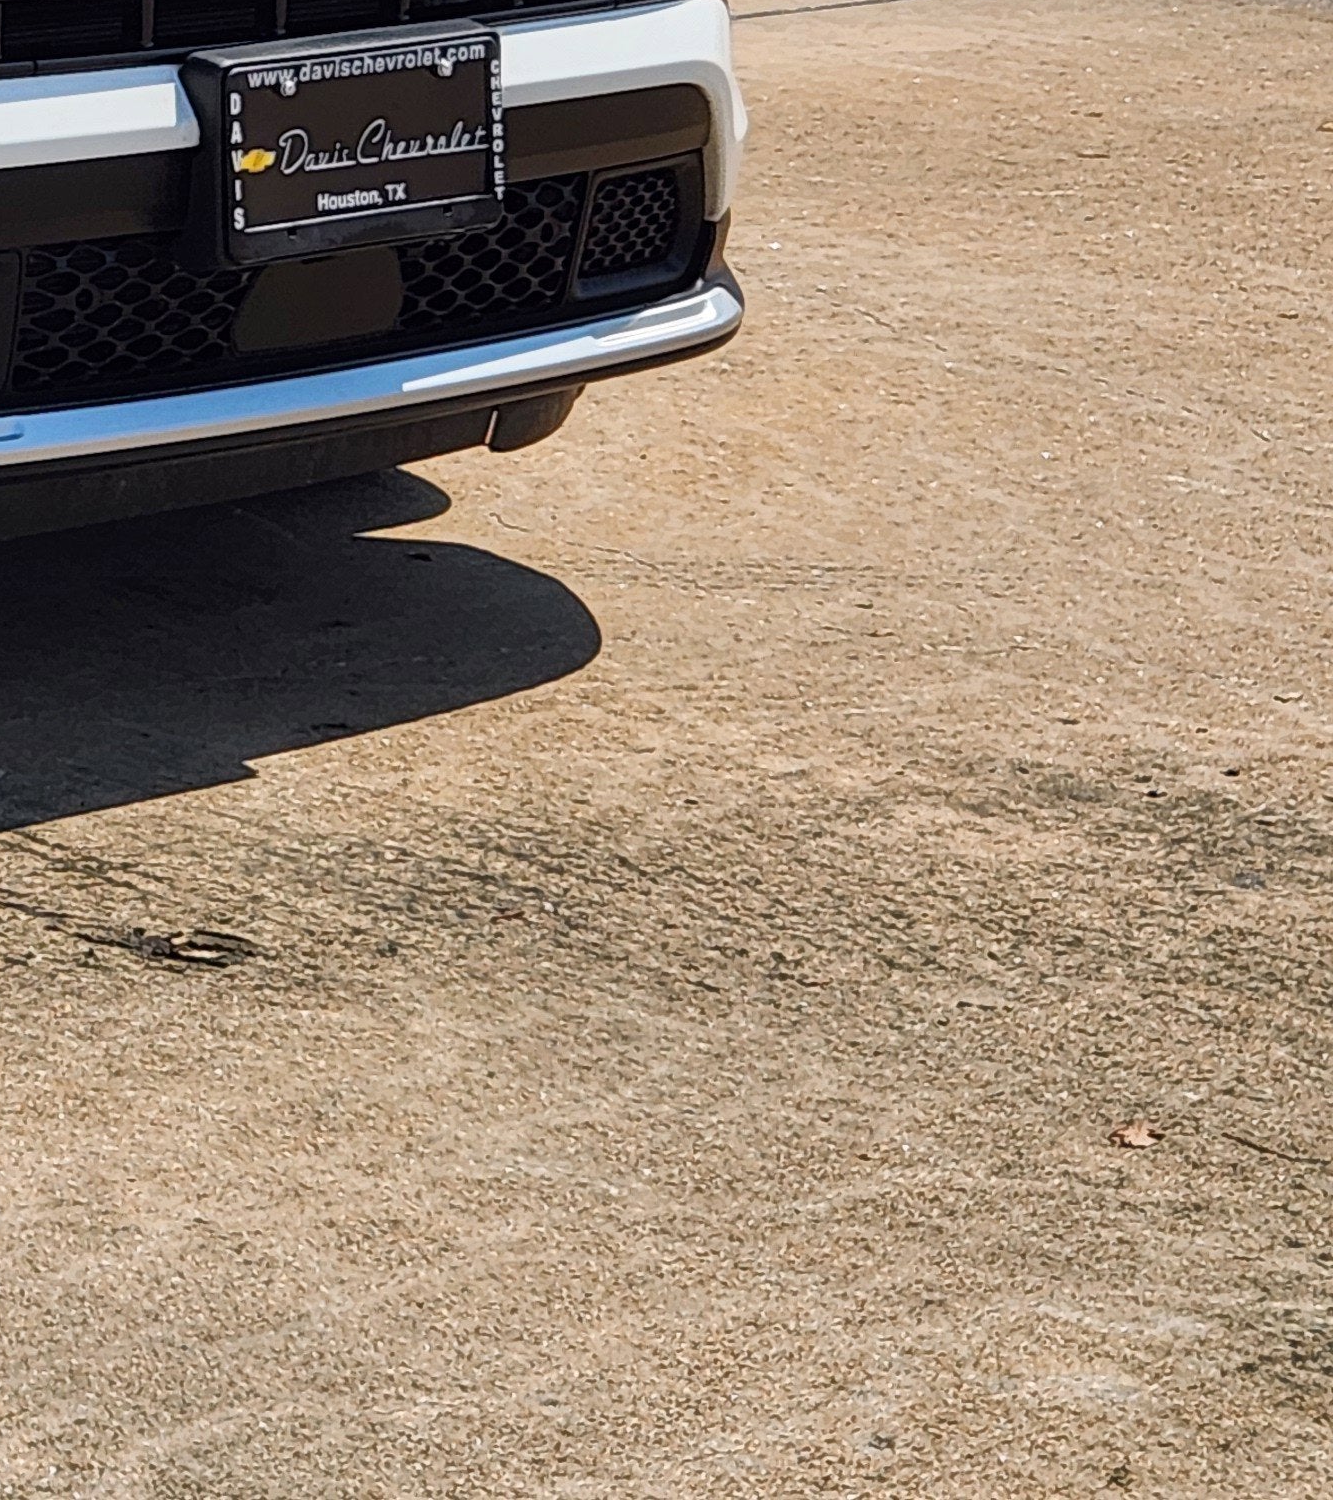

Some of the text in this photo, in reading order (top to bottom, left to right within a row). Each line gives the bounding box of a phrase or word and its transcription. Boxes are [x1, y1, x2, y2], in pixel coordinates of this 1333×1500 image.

[247, 44, 486, 88] www.davischevroletcom
[278, 118, 490, 176] Davis Chevrolet
[490, 59, 506, 201] CHEVROLET
[316, 182, 408, 212] Houston, TX
